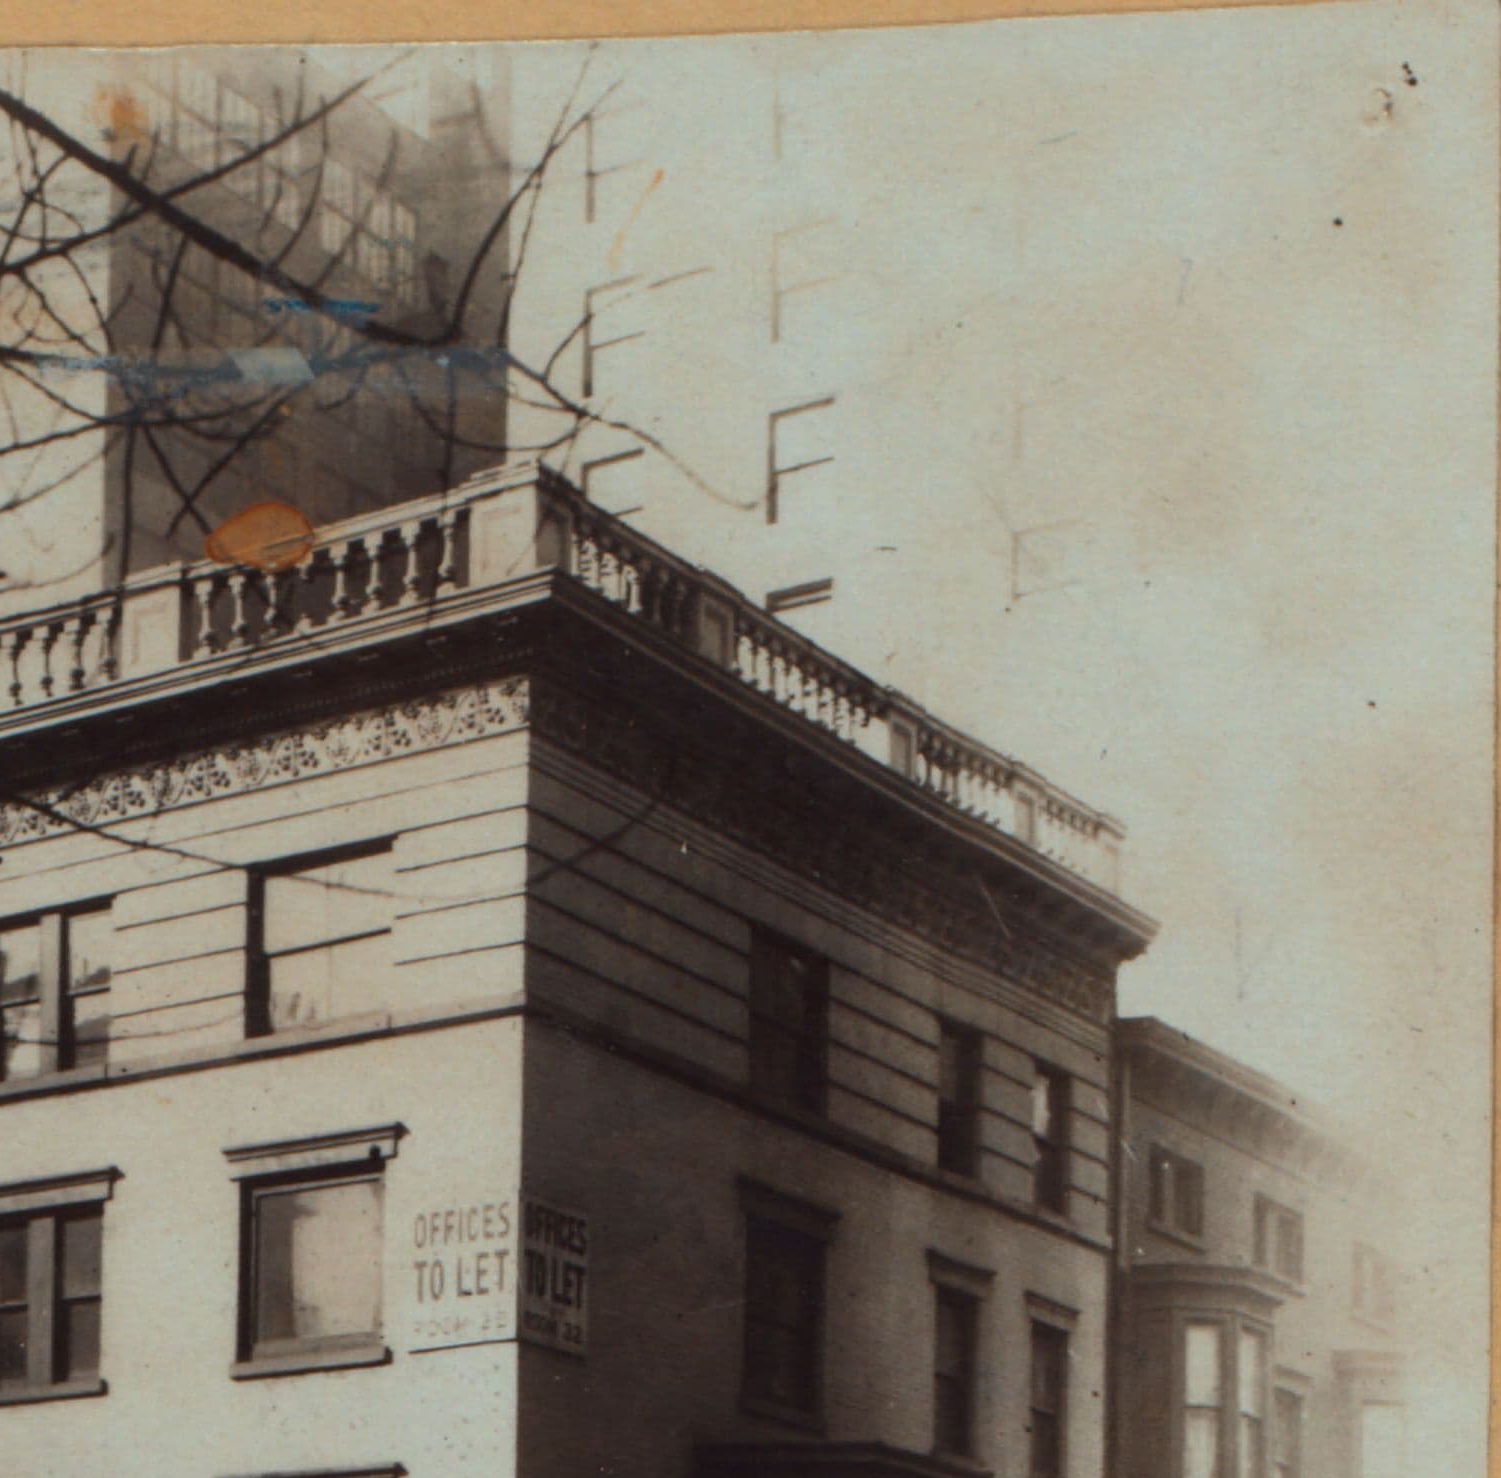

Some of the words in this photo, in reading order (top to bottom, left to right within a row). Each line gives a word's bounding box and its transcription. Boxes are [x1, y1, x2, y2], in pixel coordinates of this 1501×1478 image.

[414, 1202, 510, 1249] OFFICES
[414, 1259, 444, 1304] TO
[457, 1249, 510, 1298] LET
[551, 1257, 586, 1310] LET
